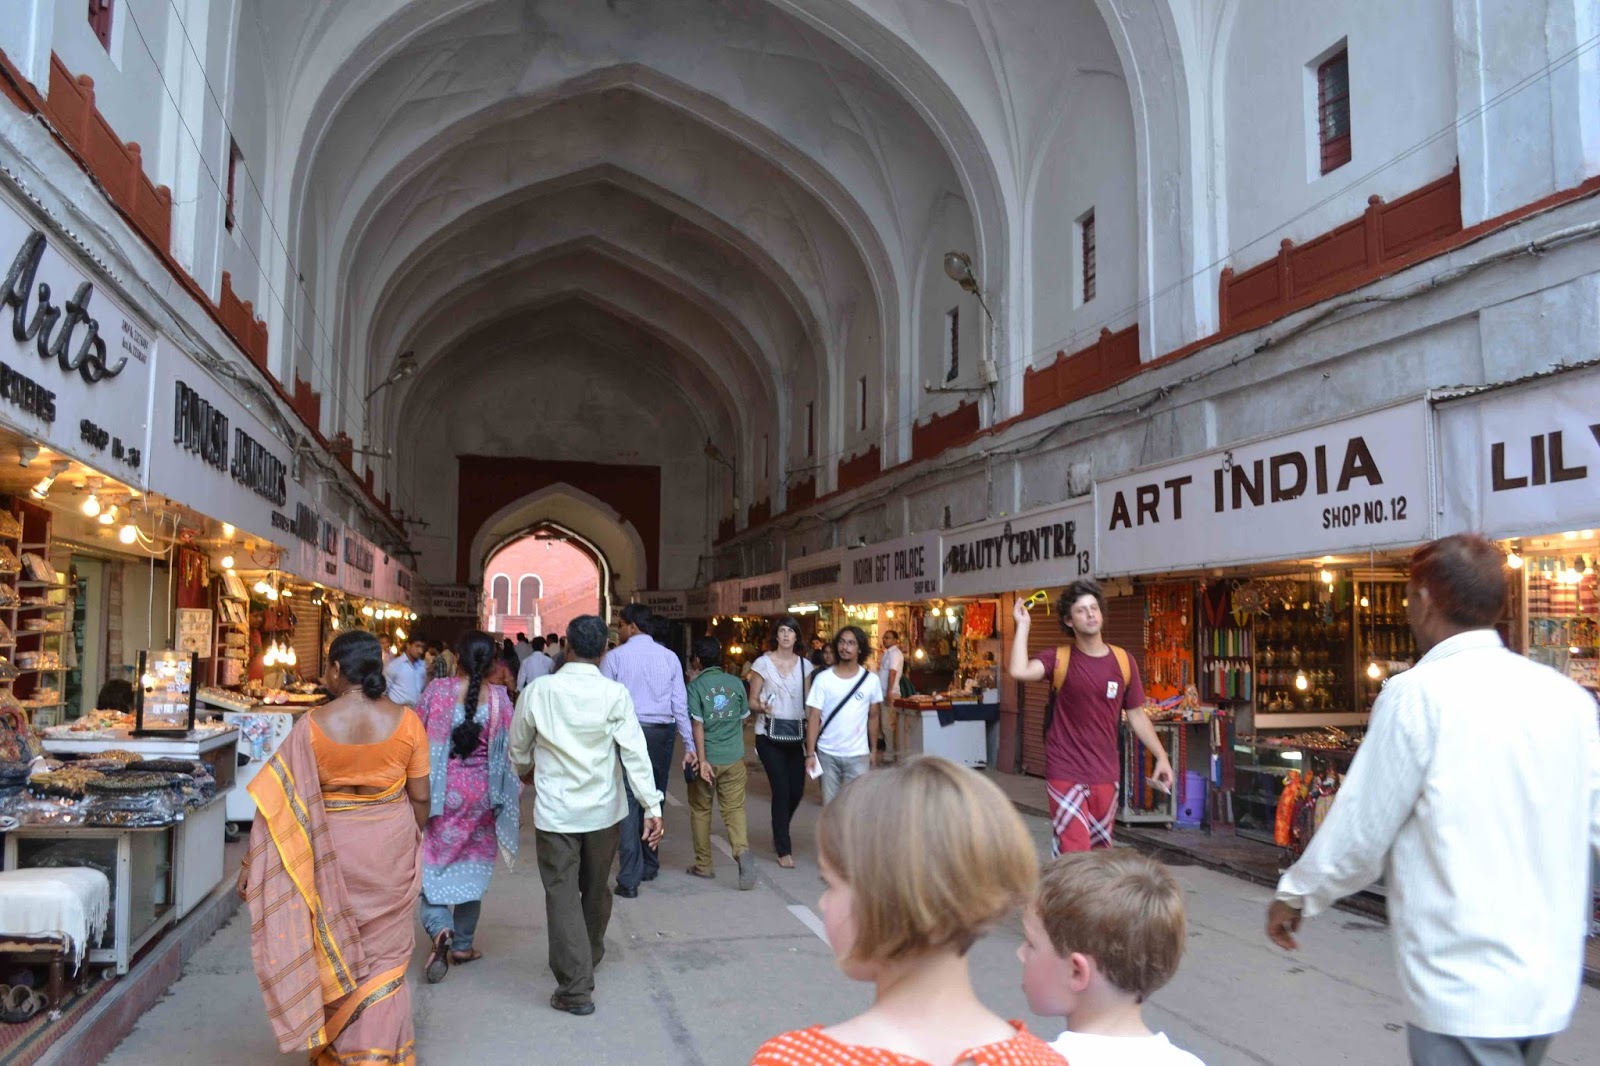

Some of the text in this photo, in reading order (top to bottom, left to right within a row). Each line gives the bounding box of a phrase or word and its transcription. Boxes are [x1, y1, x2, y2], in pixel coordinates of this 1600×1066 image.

[1109, 436, 1384, 531] ART INDIA
[1322, 504, 1361, 529] SHOP
[951, 537, 1002, 574] BEAUTY
[1008, 521, 1077, 566] CENTRE
[1077, 550, 1090, 575] 13
[876, 553, 890, 582] GIFT
[894, 546, 924, 580] PALACE
[648, 596, 678, 604] KASHMIR
